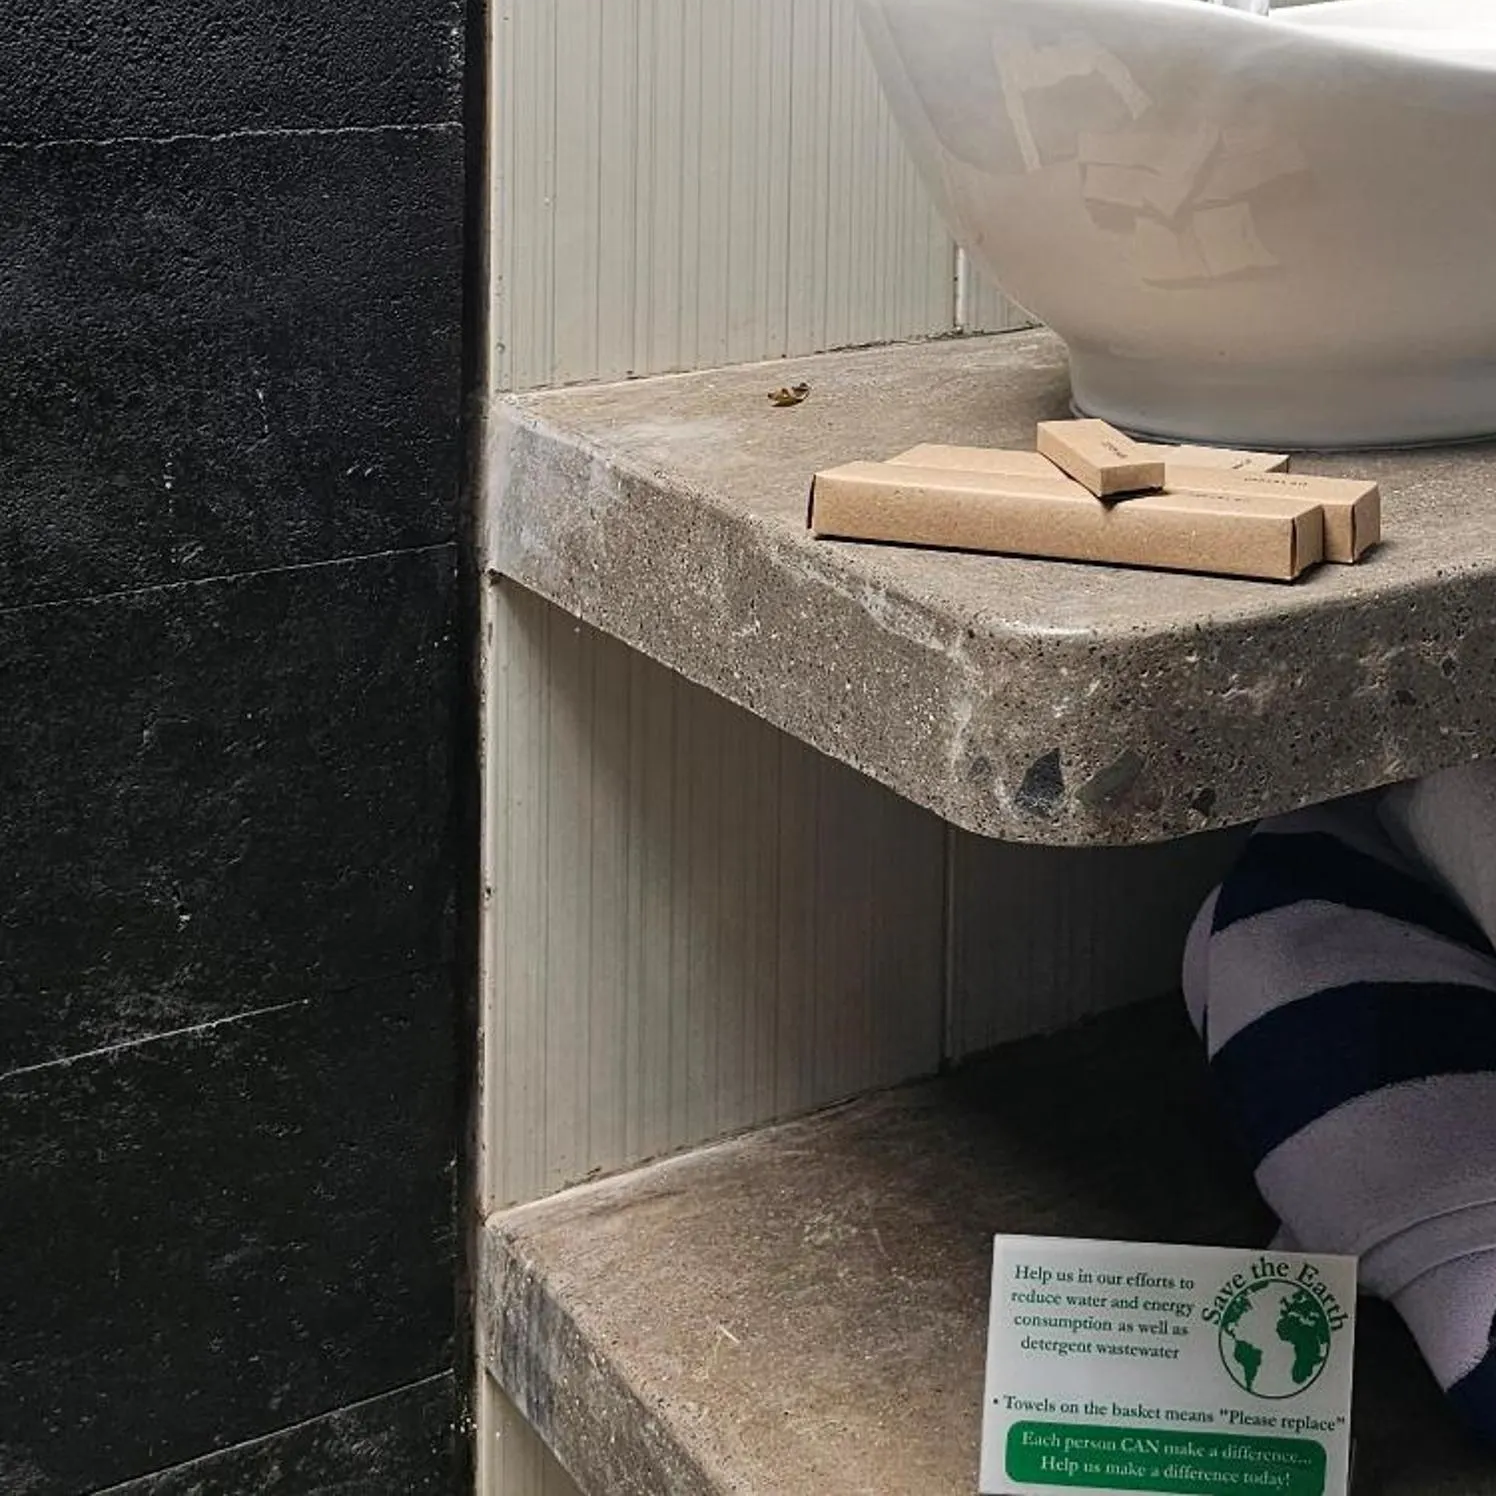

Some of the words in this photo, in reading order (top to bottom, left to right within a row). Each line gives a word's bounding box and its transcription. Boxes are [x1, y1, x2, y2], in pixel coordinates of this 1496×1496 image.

[1015, 1265, 1052, 1284] Help
[1057, 1271, 1073, 1281] us
[1078, 1269, 1092, 1283] in
[1097, 1274, 1122, 1285] our
[1126, 1273, 1175, 1288] efforts
[1180, 1278, 1194, 1289] to
[1011, 1290, 1062, 1304] reduce
[1067, 1296, 1106, 1307] water
[1111, 1297, 1138, 1309] and
[1143, 1301, 1195, 1317] energy
[1201, 1274, 1247, 1325] Save
[1252, 1257, 1289, 1278] the
[1296, 1263, 1348, 1330] Earth
[1014, 1315, 1112, 1333] consumption
[1118, 1321, 1133, 1332] as
[1138, 1321, 1168, 1334] well
[1173, 1326, 1189, 1335] as
[1021, 1336, 1092, 1356] detergent
[1096, 1346, 1179, 1359] wastewater
[1003, 1396, 1055, 1412] Towels
[1060, 1403, 1079, 1413] on
[1084, 1402, 1107, 1416] the
[1112, 1403, 1161, 1419] basket
[1165, 1411, 1214, 1422] means
[1220, 1409, 1277, 1427] "Please
[1281, 1416, 1345, 1432] replace"
[1022, 1432, 1060, 1447] Each
[1065, 1438, 1116, 1454] person
[1120, 1438, 1159, 1453] CAN
[1164, 1443, 1203, 1457] make
[1210, 1449, 1218, 1458] a
[1040, 1456, 1078, 1476] Help
[1083, 1463, 1100, 1472] us
[1106, 1462, 1145, 1476] make
[1150, 1468, 1159, 1477] a
[1163, 1464, 1241, 1483] difference
[1244, 1471, 1290, 1487] today!
